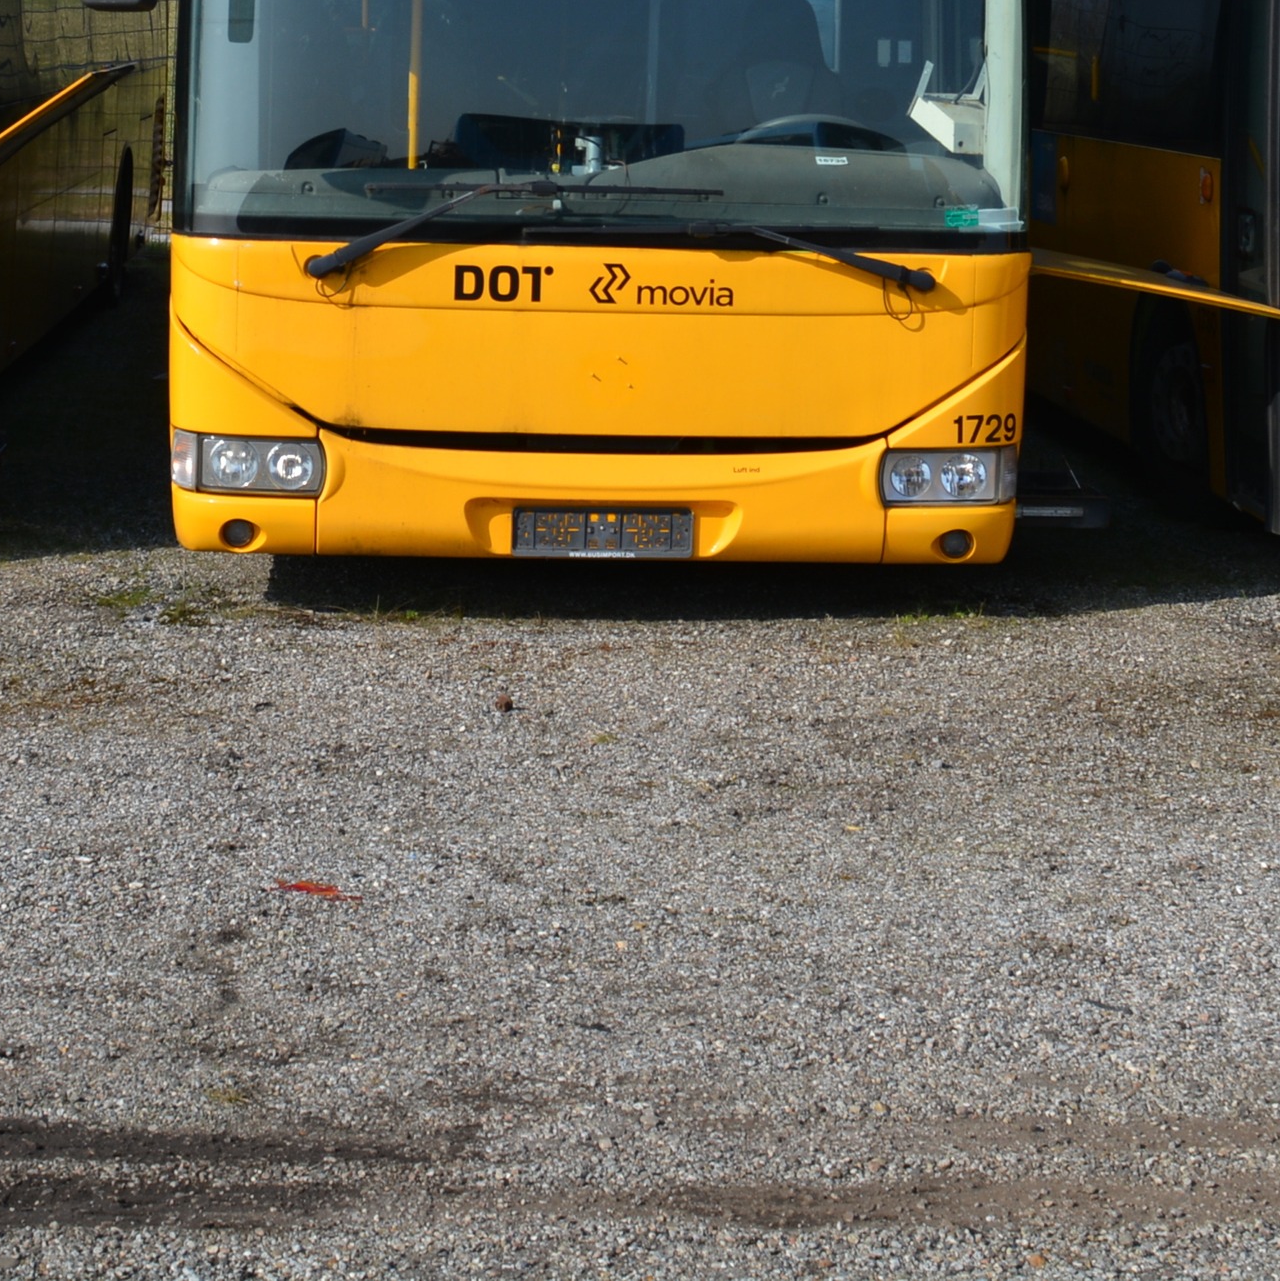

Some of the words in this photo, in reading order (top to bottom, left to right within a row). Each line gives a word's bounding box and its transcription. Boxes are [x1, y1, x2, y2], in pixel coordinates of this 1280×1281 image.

[454, 265, 554, 302] DOT
[637, 280, 734, 307] movia
[953, 413, 1017, 445] 1729
